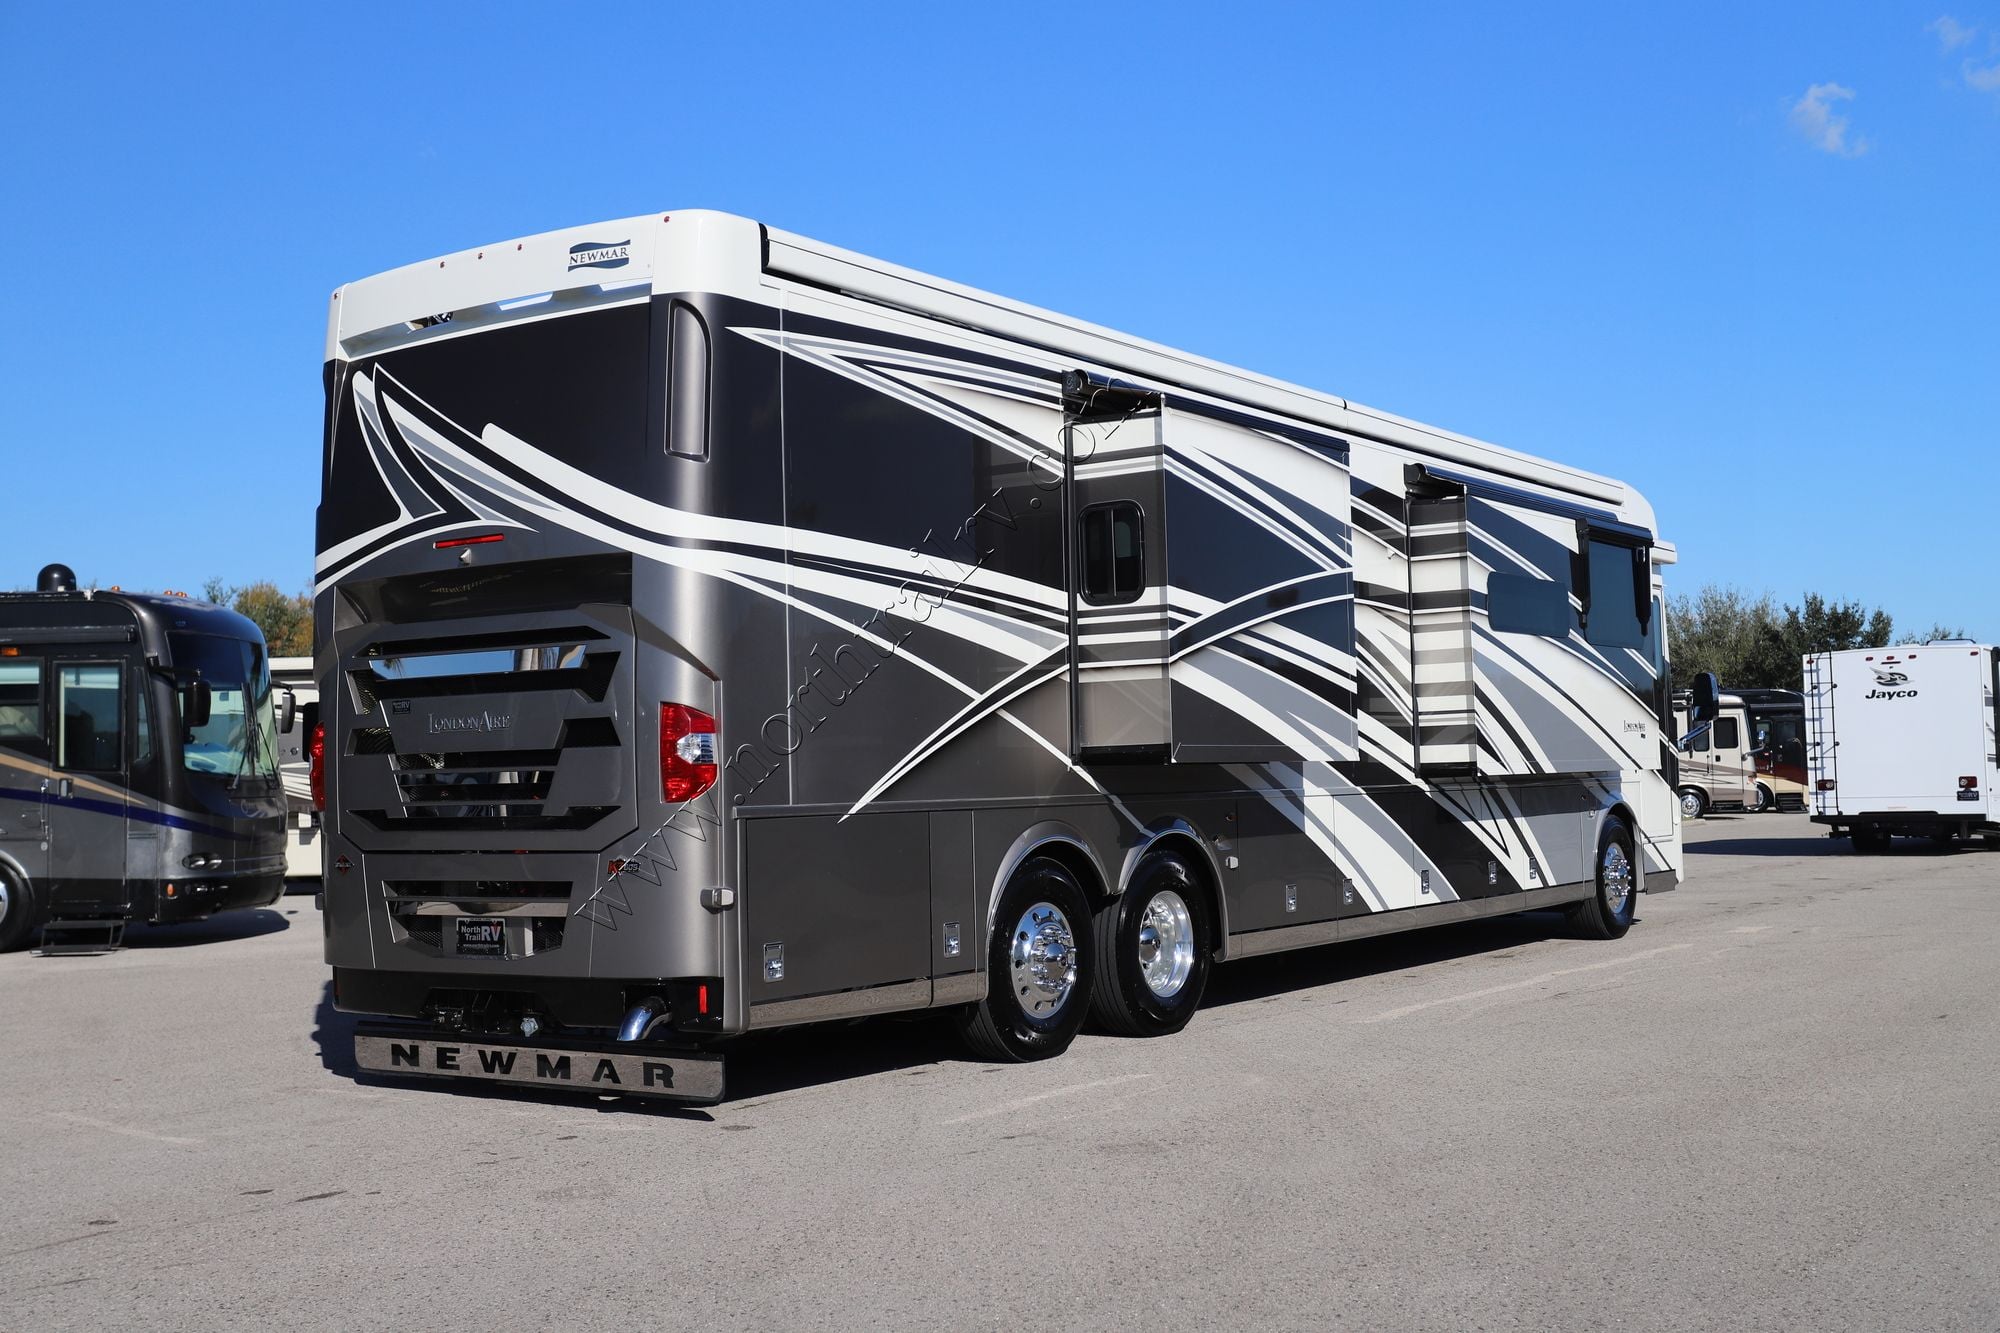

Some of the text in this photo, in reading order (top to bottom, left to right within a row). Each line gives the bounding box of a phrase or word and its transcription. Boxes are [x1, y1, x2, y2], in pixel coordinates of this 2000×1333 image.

[569, 246, 629, 265] NEWMAR
[1865, 689, 1918, 701] Jayco
[481, 926, 501, 941] RV
[390, 1043, 675, 1089] NEWMAR
